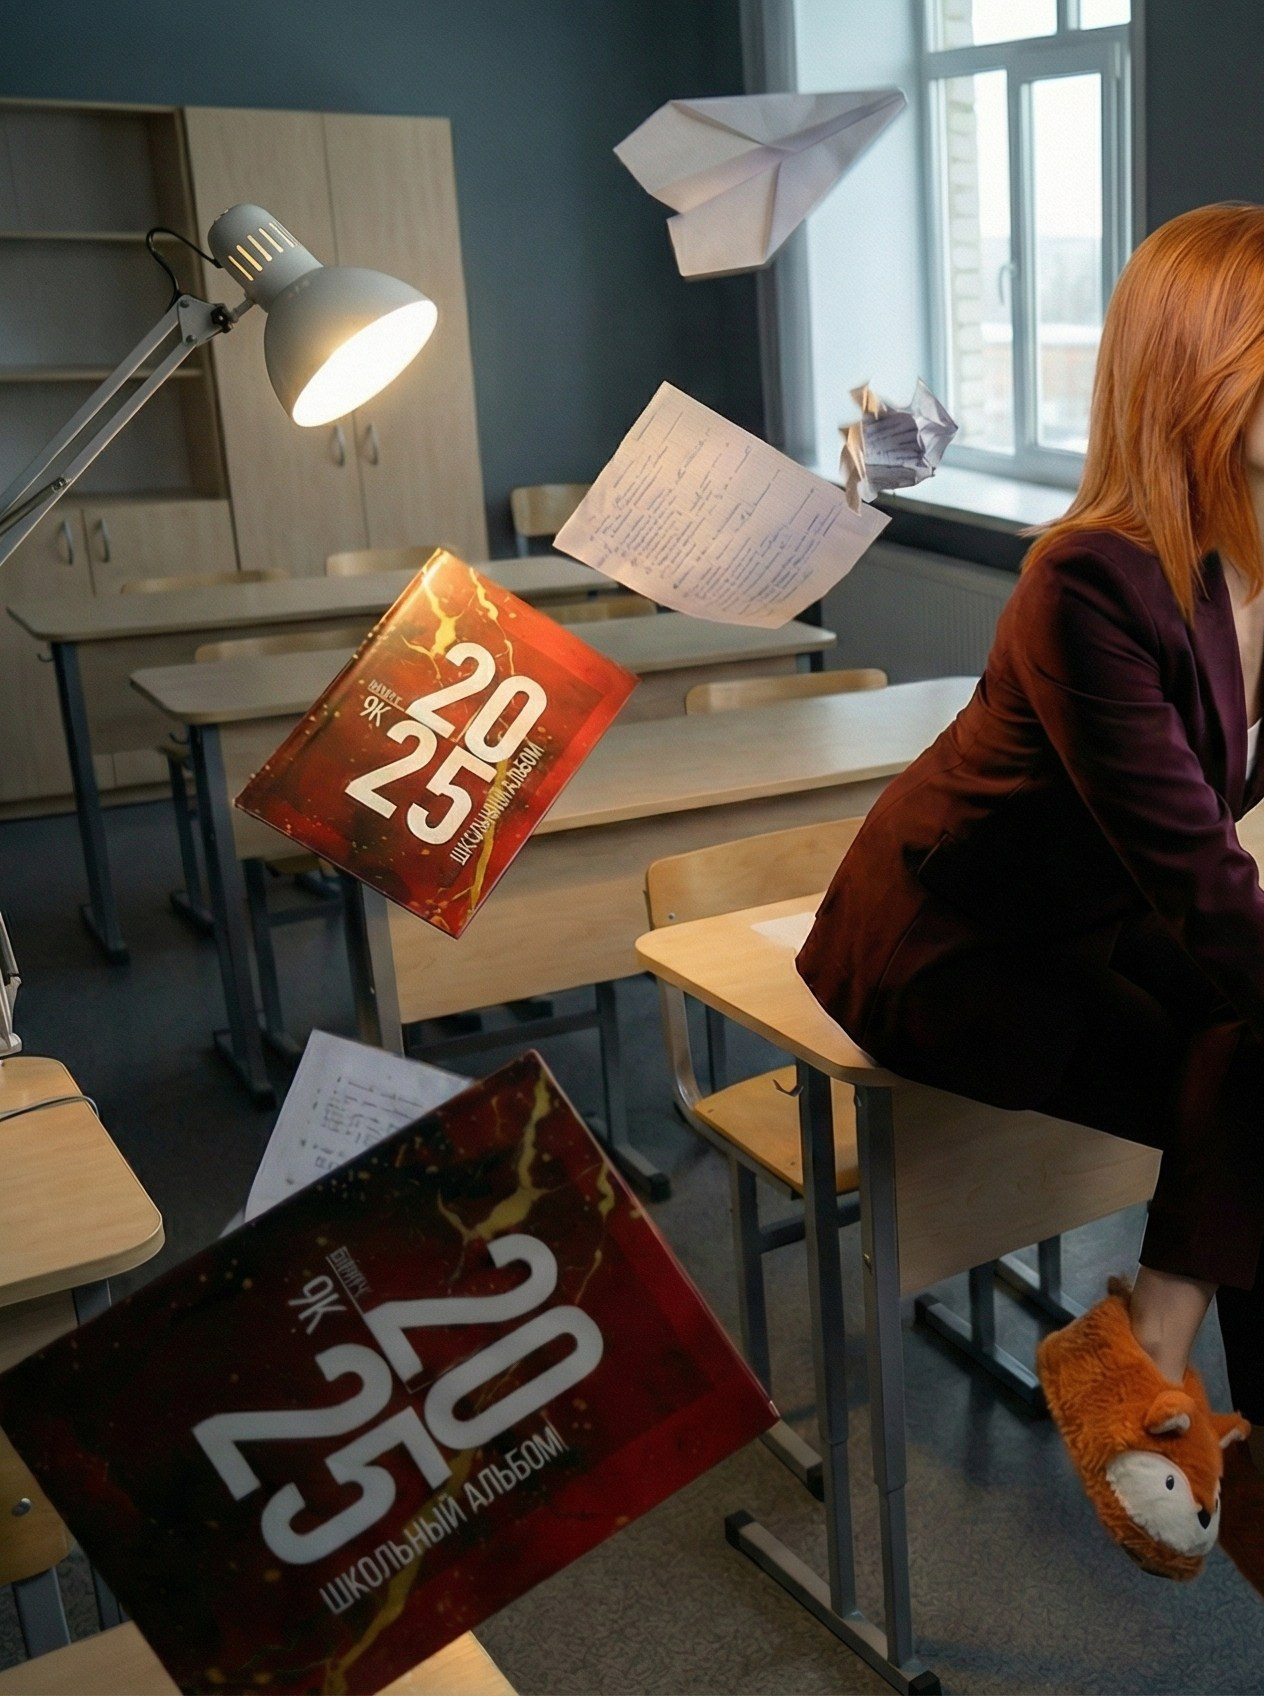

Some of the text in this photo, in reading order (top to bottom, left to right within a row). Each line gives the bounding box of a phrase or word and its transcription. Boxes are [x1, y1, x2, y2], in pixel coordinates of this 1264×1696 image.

[344, 720, 497, 844] 25
[405, 642, 547, 763] 20
[362, 1233, 604, 1449] 20
[191, 1344, 452, 1565] 25
[317, 1426, 565, 1615] ШКОЛЬНЫЙ АЛЬБОМ
